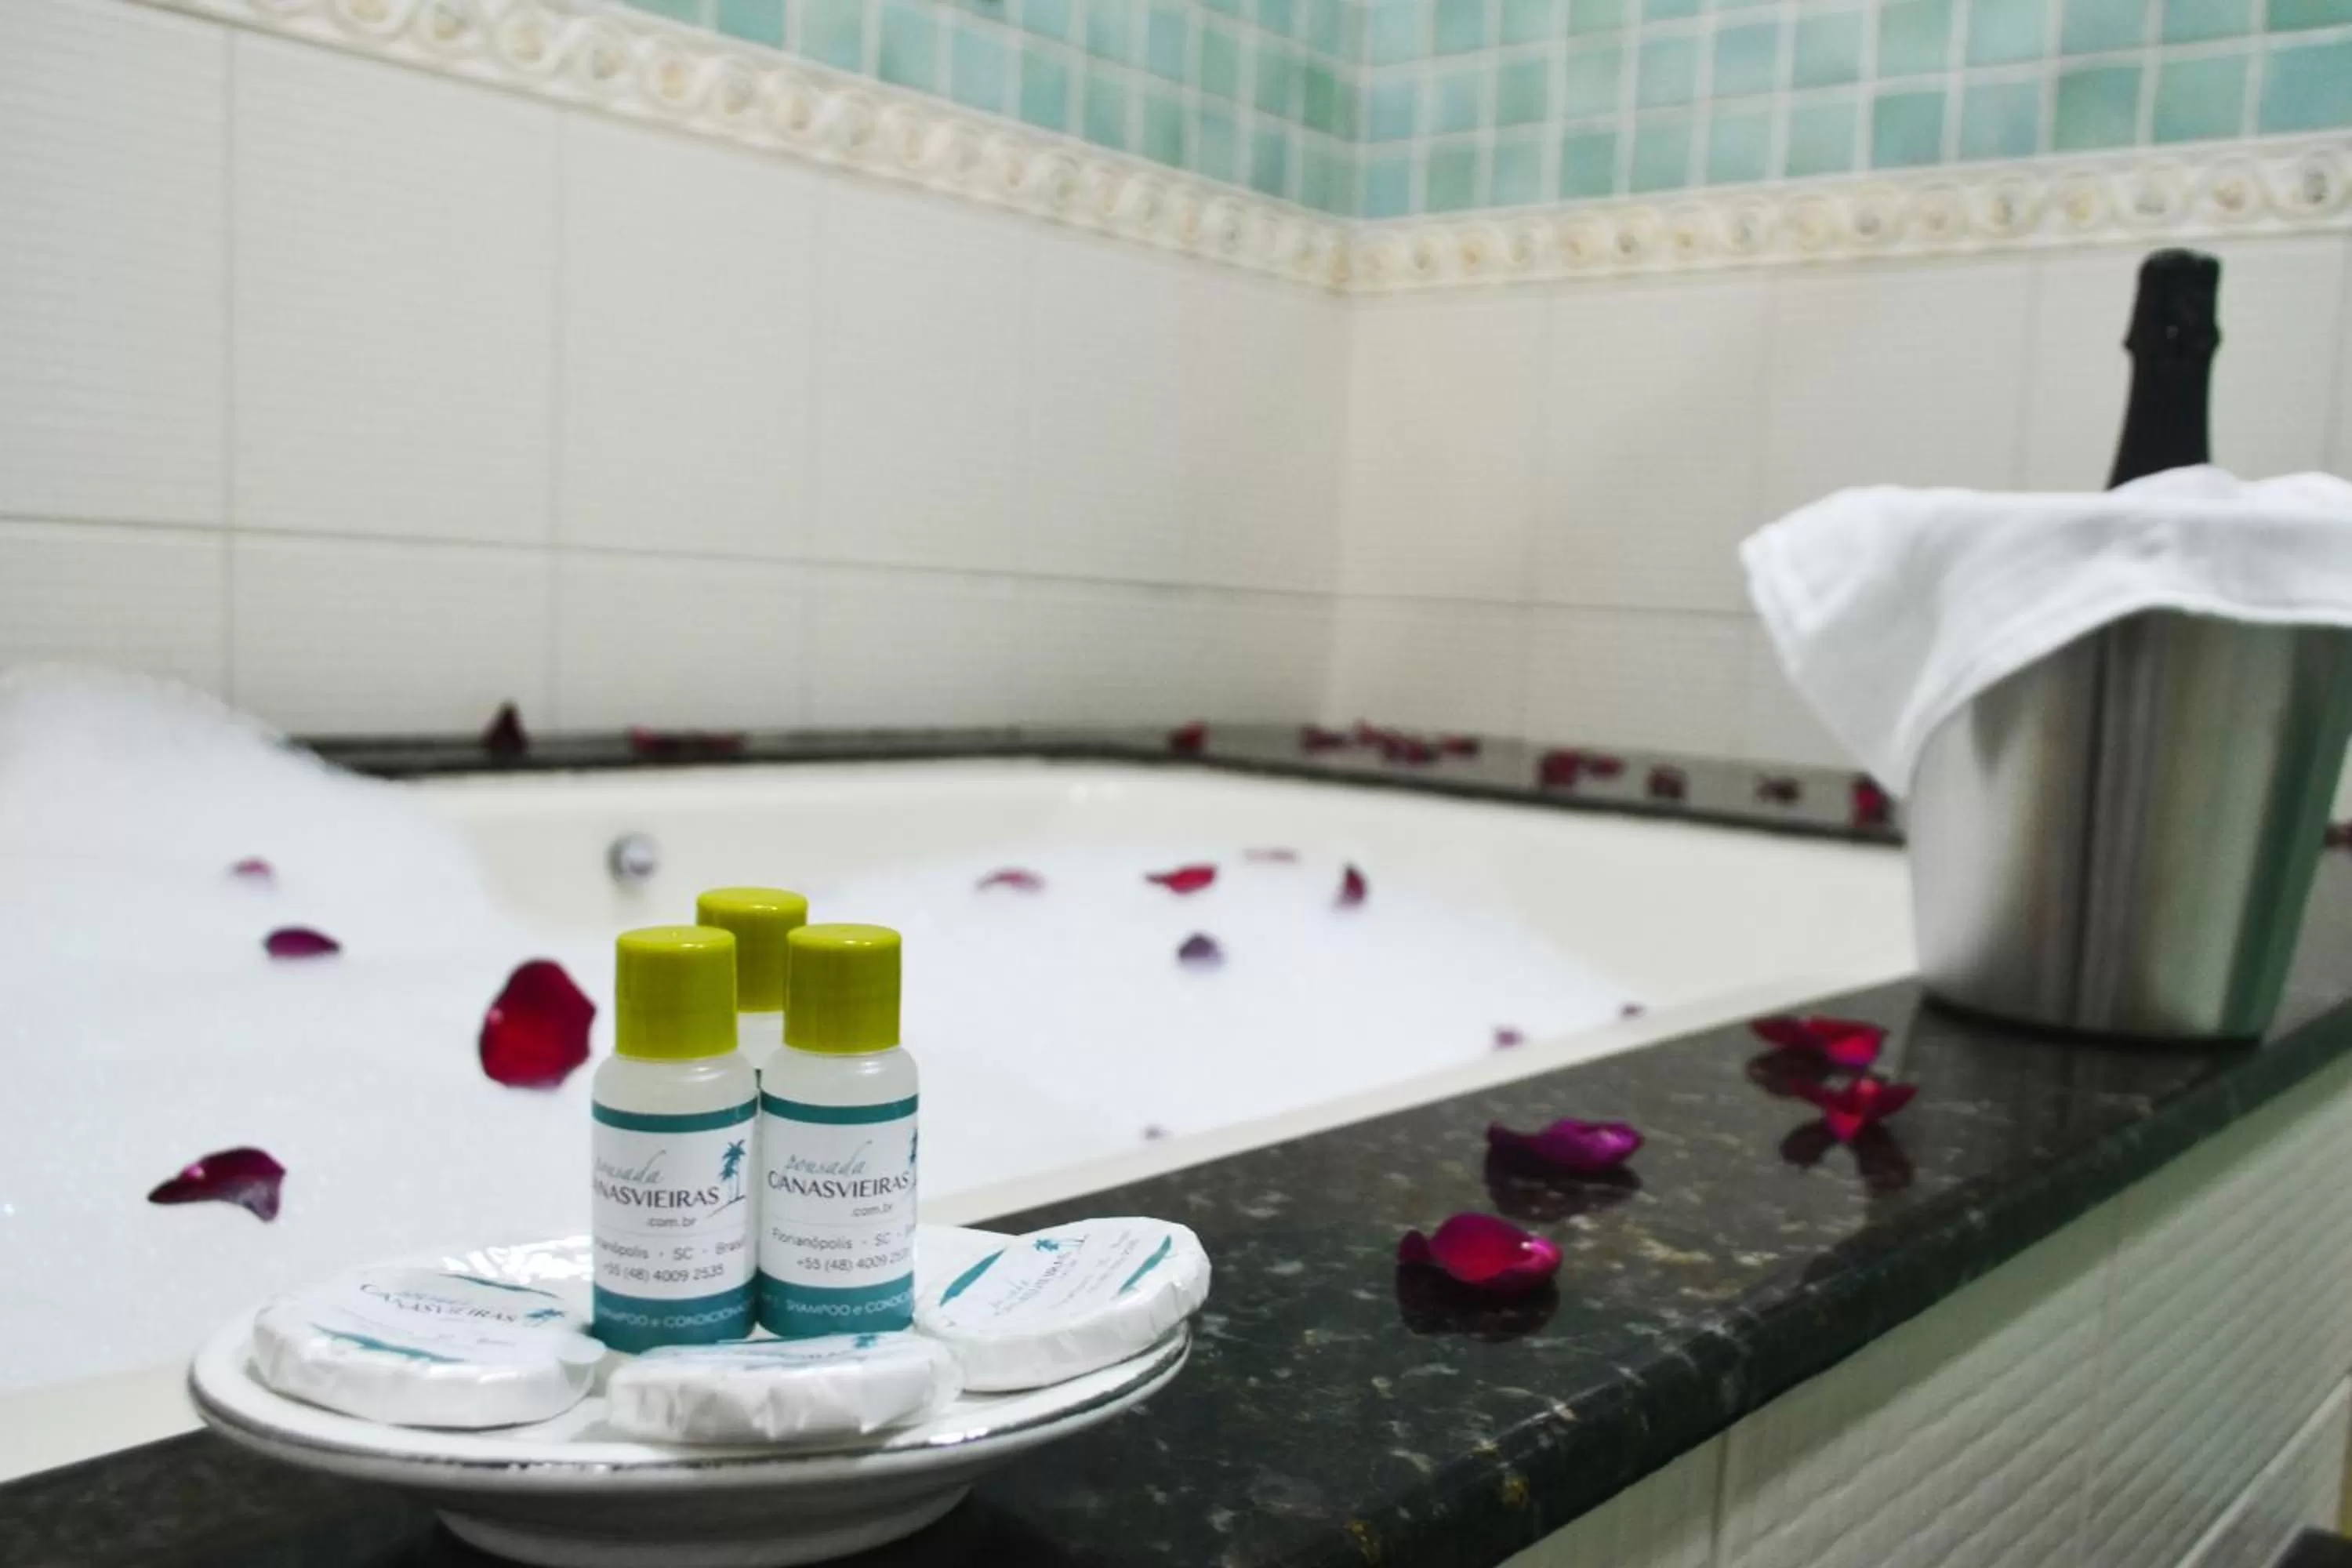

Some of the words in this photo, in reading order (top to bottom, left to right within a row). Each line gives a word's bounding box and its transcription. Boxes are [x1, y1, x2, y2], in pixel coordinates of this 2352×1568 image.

[593, 1178, 720, 1208] NASVIEIRAS
[768, 1170, 910, 1199] CANASVIEIRAS
[673, 1246, 694, 1261] SC
[652, 1269, 689, 1283] 4009
